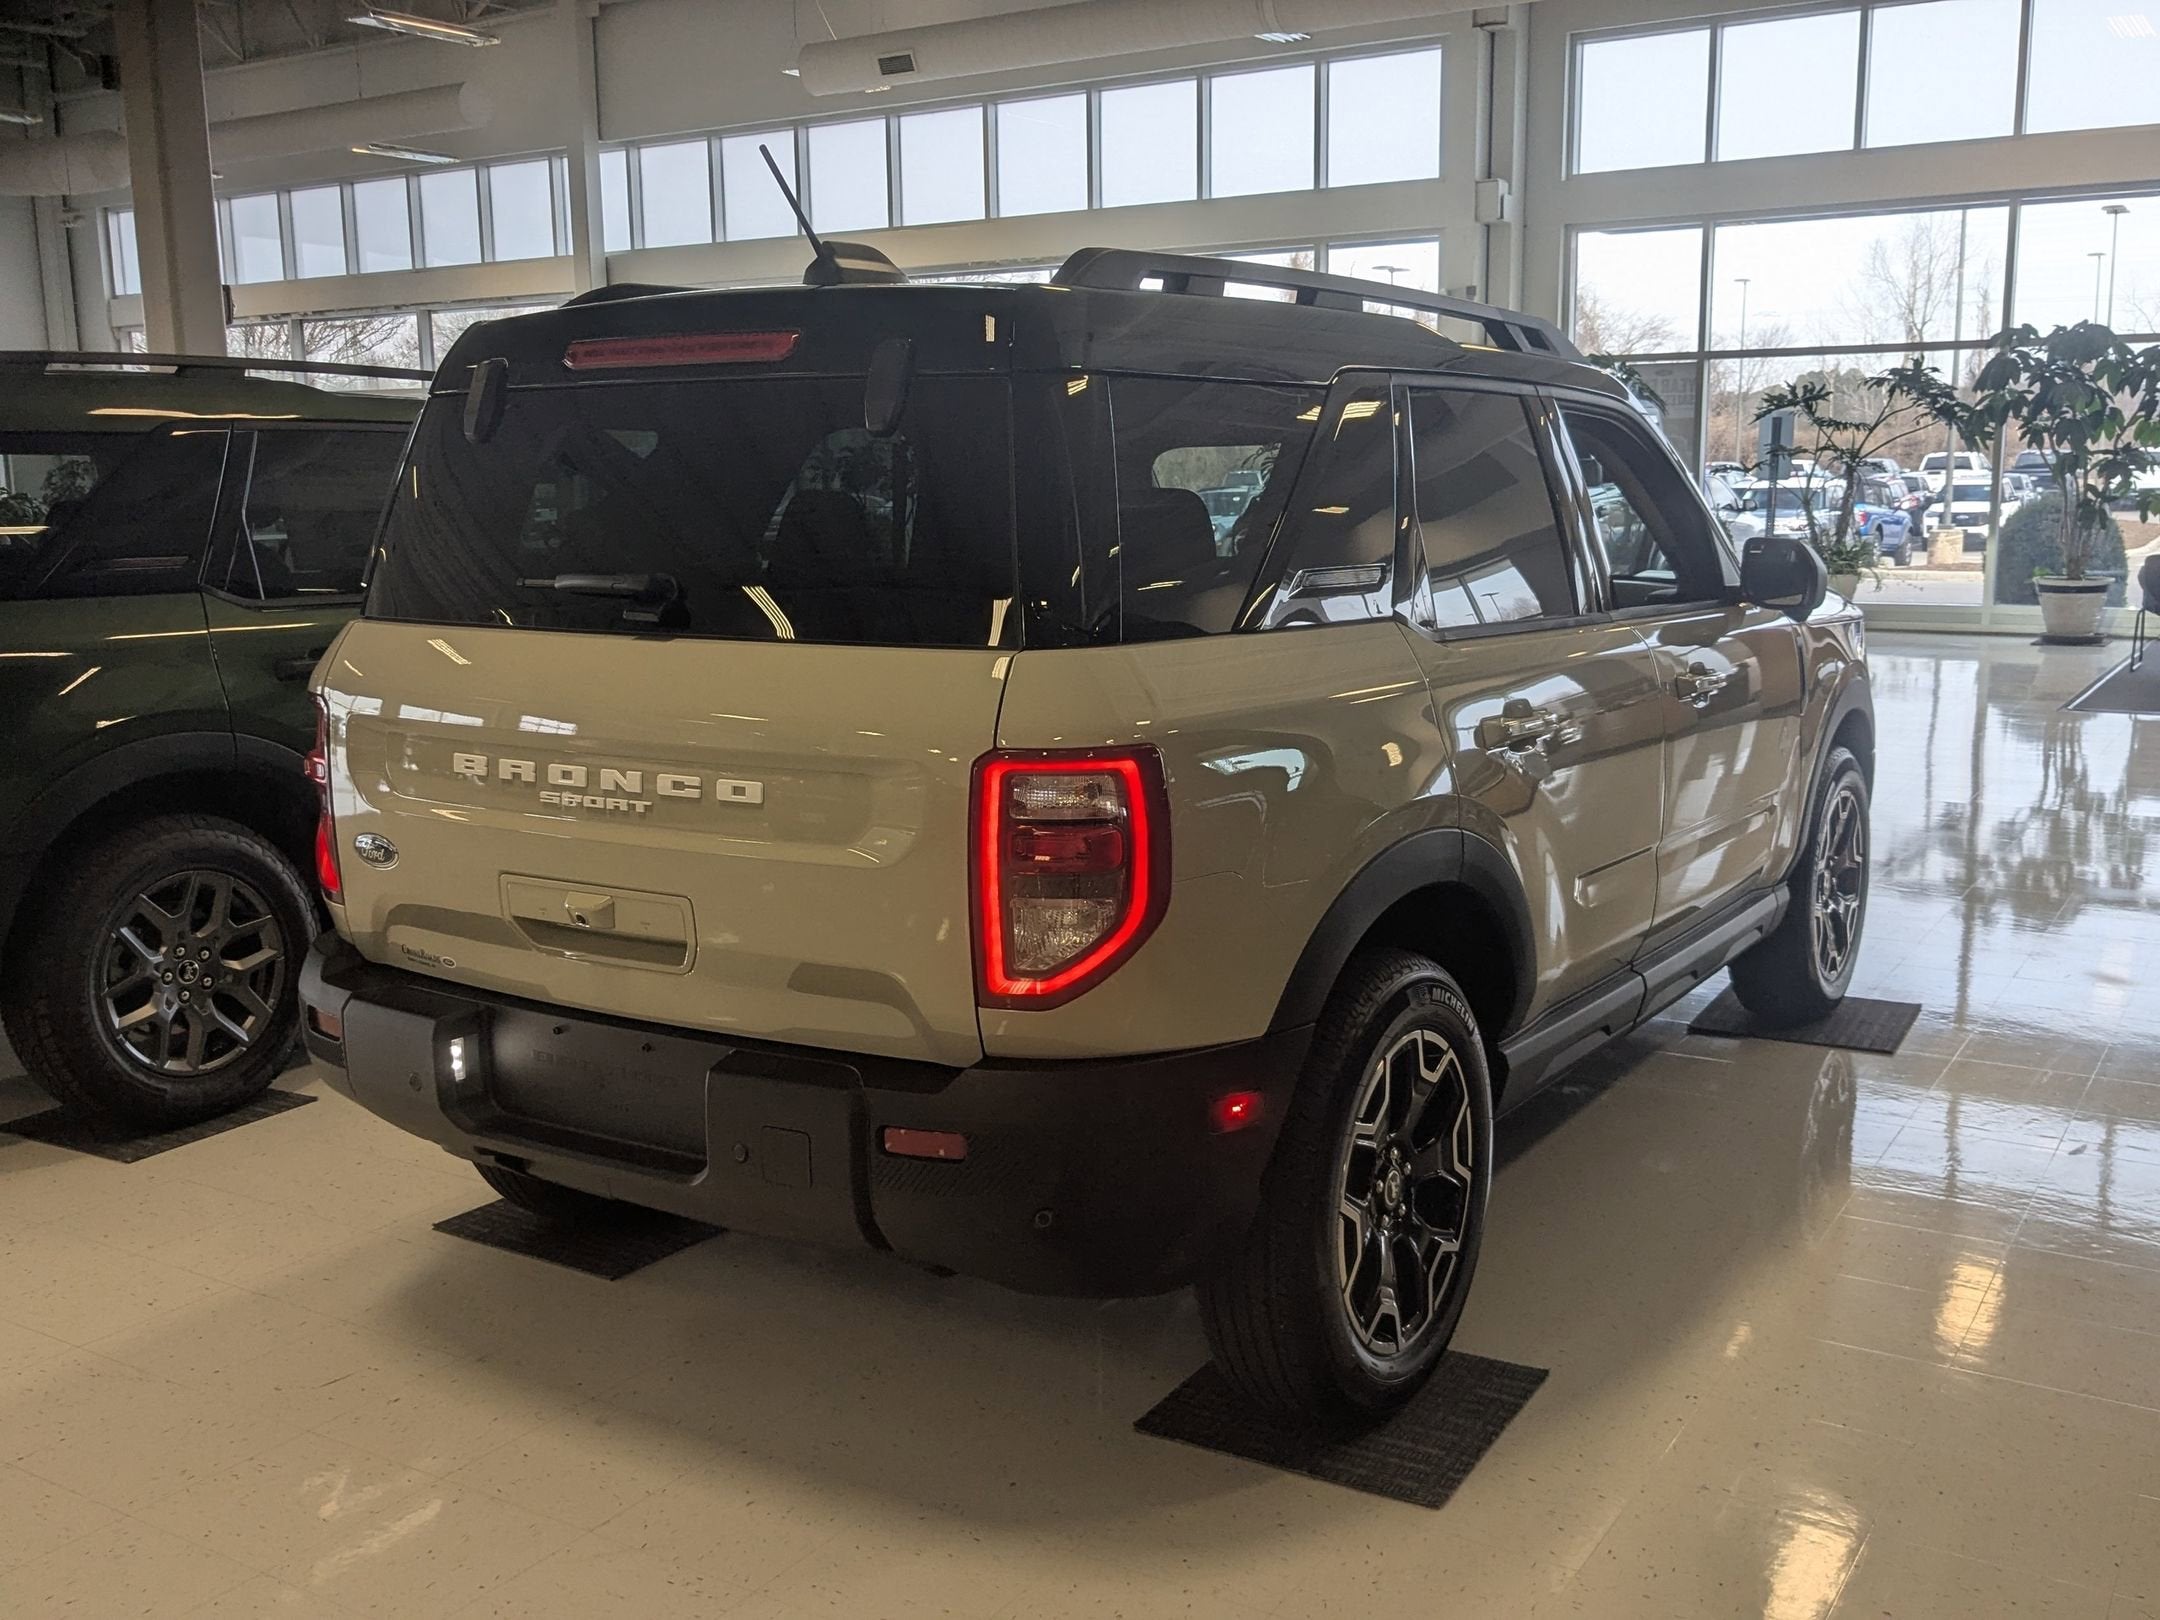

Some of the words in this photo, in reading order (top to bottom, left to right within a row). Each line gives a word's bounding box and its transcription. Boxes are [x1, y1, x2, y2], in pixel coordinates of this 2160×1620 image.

[454, 752, 764, 804] BRONCO
[540, 791, 652, 813] SPORT
[1431, 987, 1474, 1032] MICHELIN
